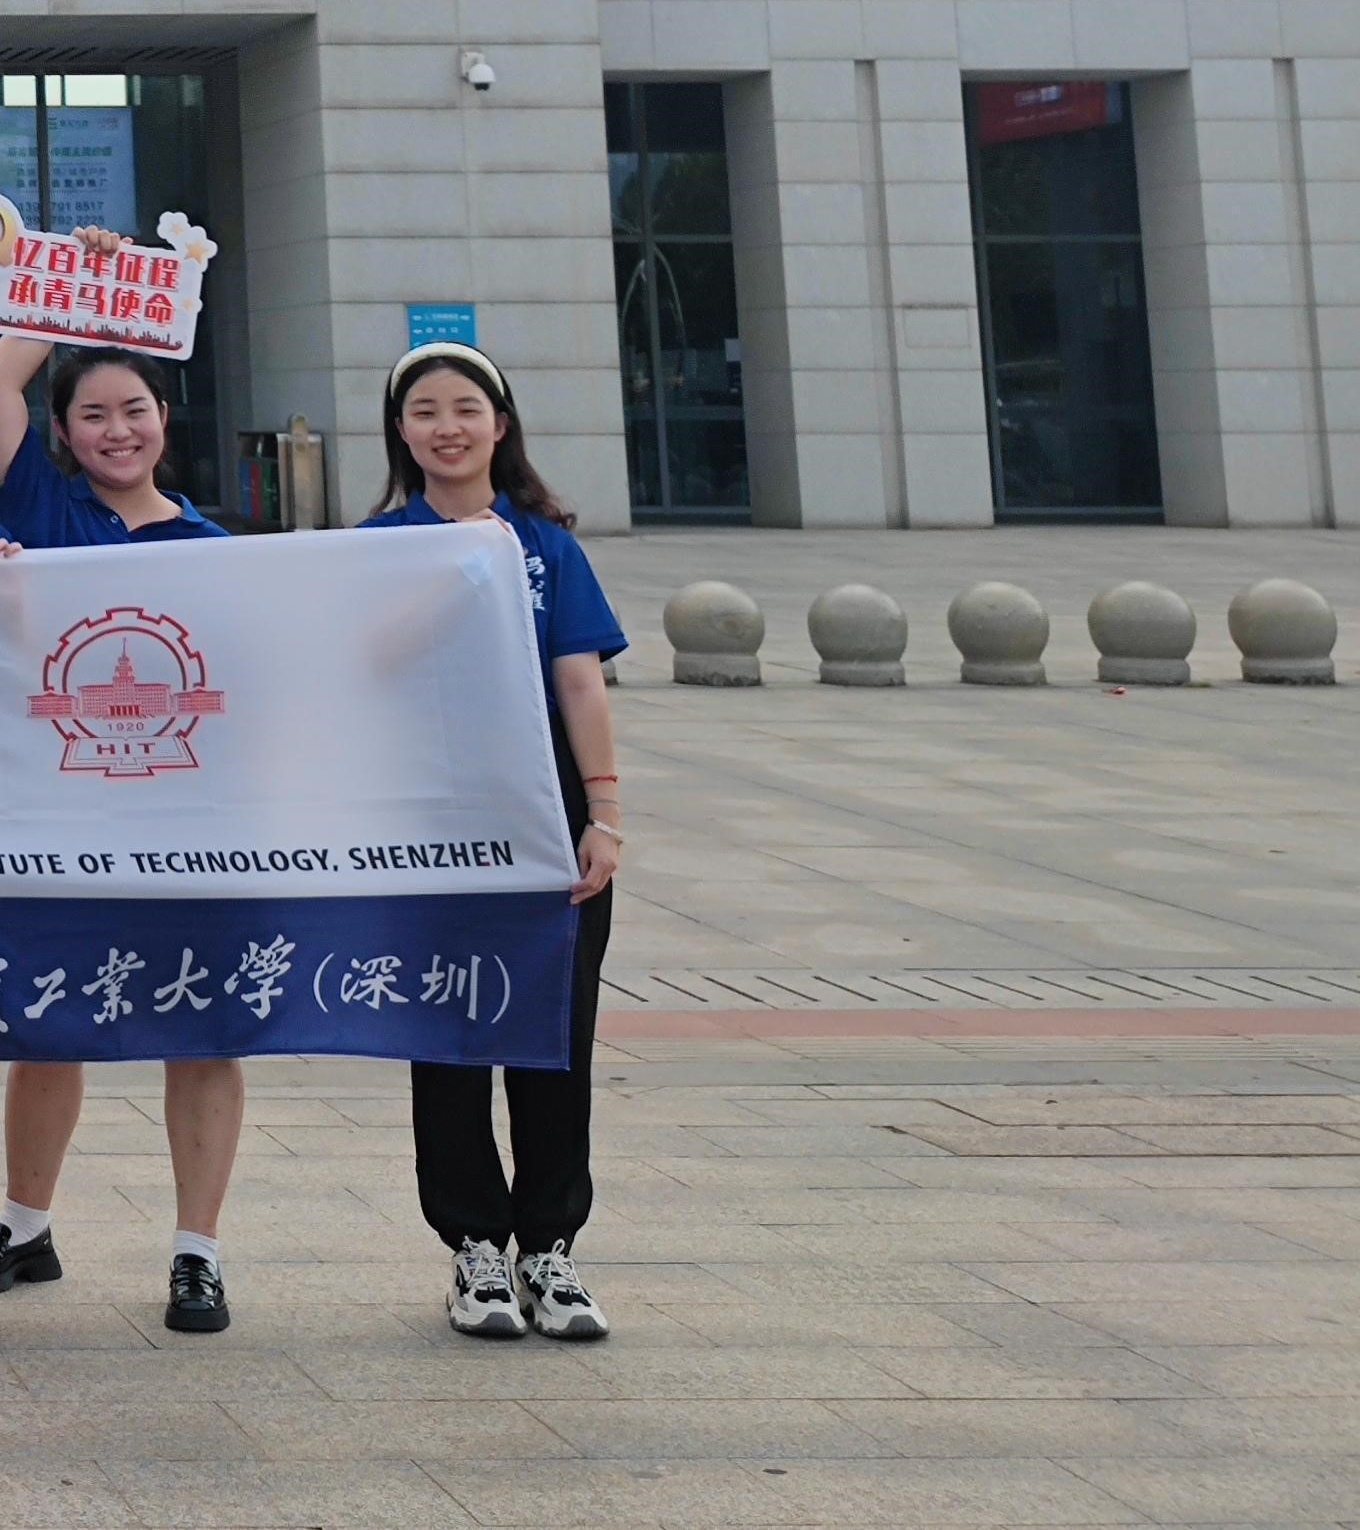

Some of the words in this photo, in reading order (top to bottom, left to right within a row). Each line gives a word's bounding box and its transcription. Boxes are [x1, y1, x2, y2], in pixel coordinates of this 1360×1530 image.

[14, 236, 180, 290] 忆百年征程
[7, 273, 176, 327] 承青马使命
[107, 721, 145, 733] 1920
[95, 742, 157, 755] HIT
[77, 852, 116, 875] OF
[130, 848, 339, 874] TECHNOLOGY,
[348, 840, 515, 871] SHENZHEN
